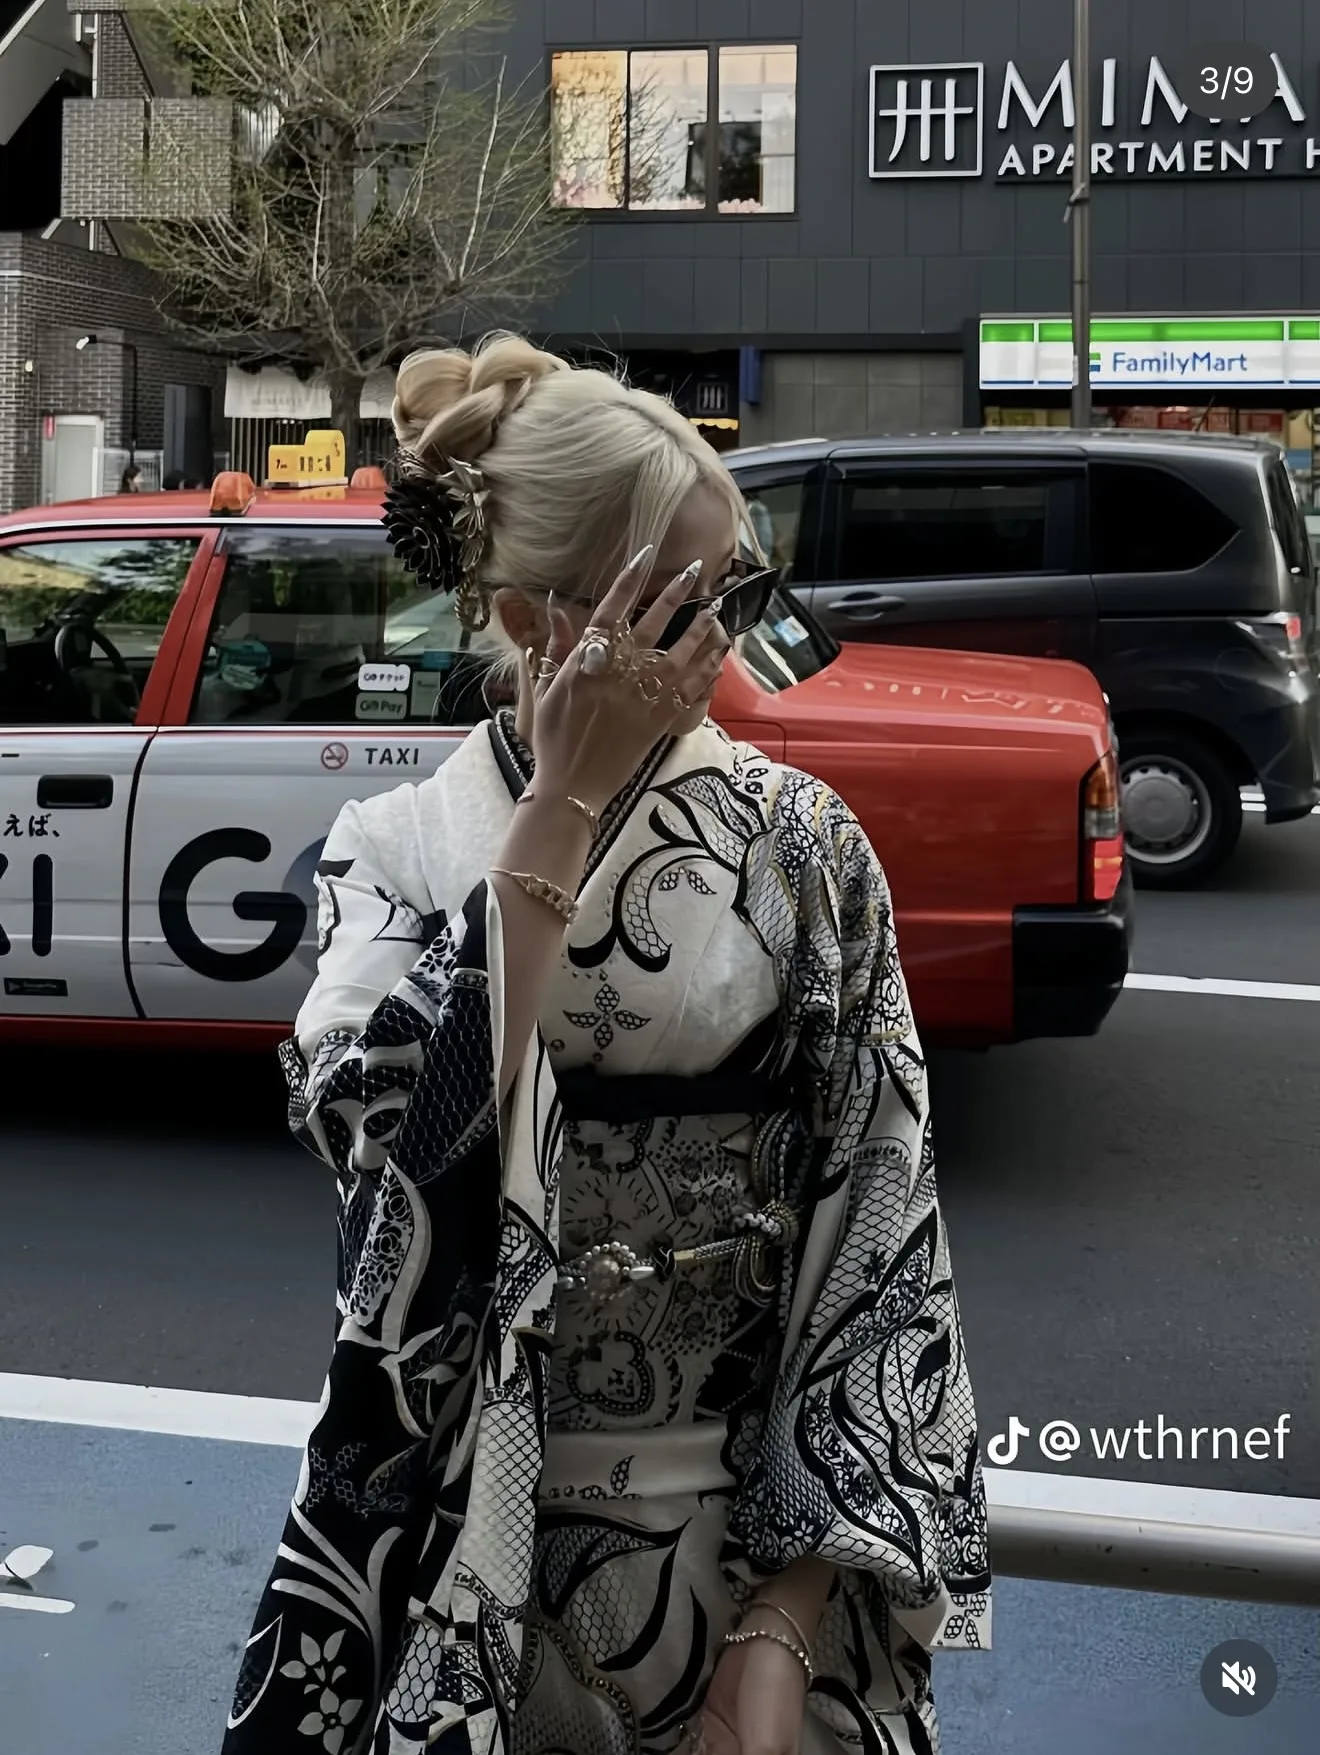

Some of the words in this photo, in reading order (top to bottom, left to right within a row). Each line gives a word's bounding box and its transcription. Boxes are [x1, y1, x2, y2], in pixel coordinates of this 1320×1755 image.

[997, 138, 1283, 176] APARTMENT
[1112, 351, 1248, 376] FamilyMart
[364, 747, 420, 766] TAXI
